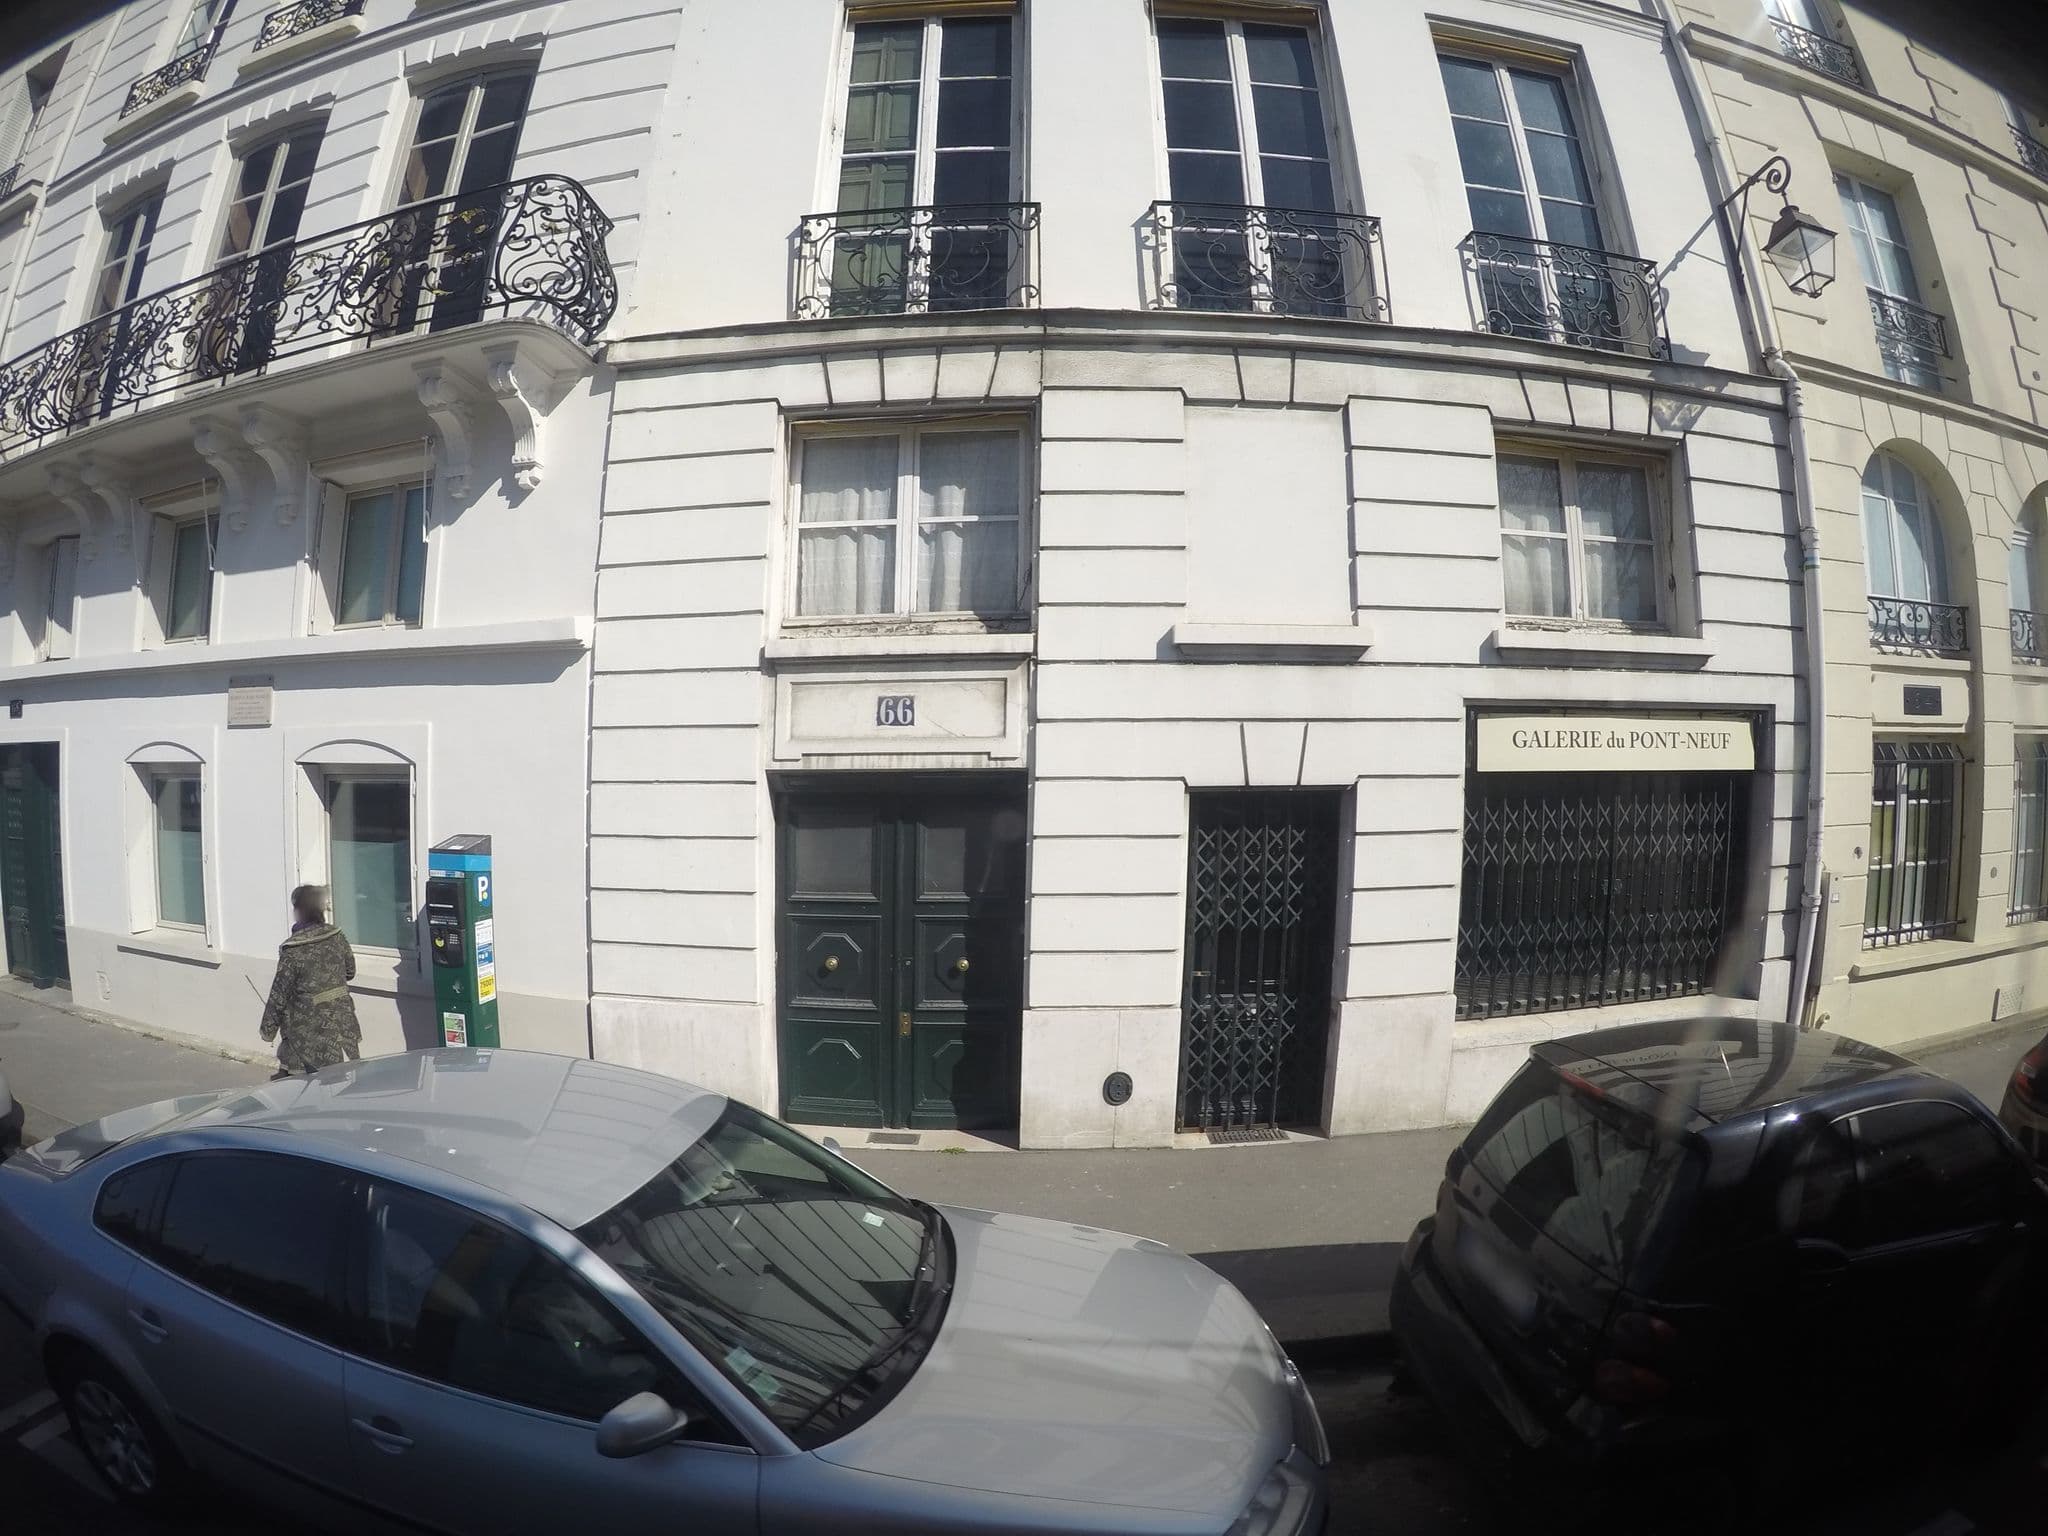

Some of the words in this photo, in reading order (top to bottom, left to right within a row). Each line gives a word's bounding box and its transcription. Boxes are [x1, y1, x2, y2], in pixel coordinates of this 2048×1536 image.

[880, 697, 913, 725] 66
[1512, 729, 1602, 749] GALERIE
[1606, 730, 1625, 749] du
[1629, 731, 1731, 750] PONT-NEUF
